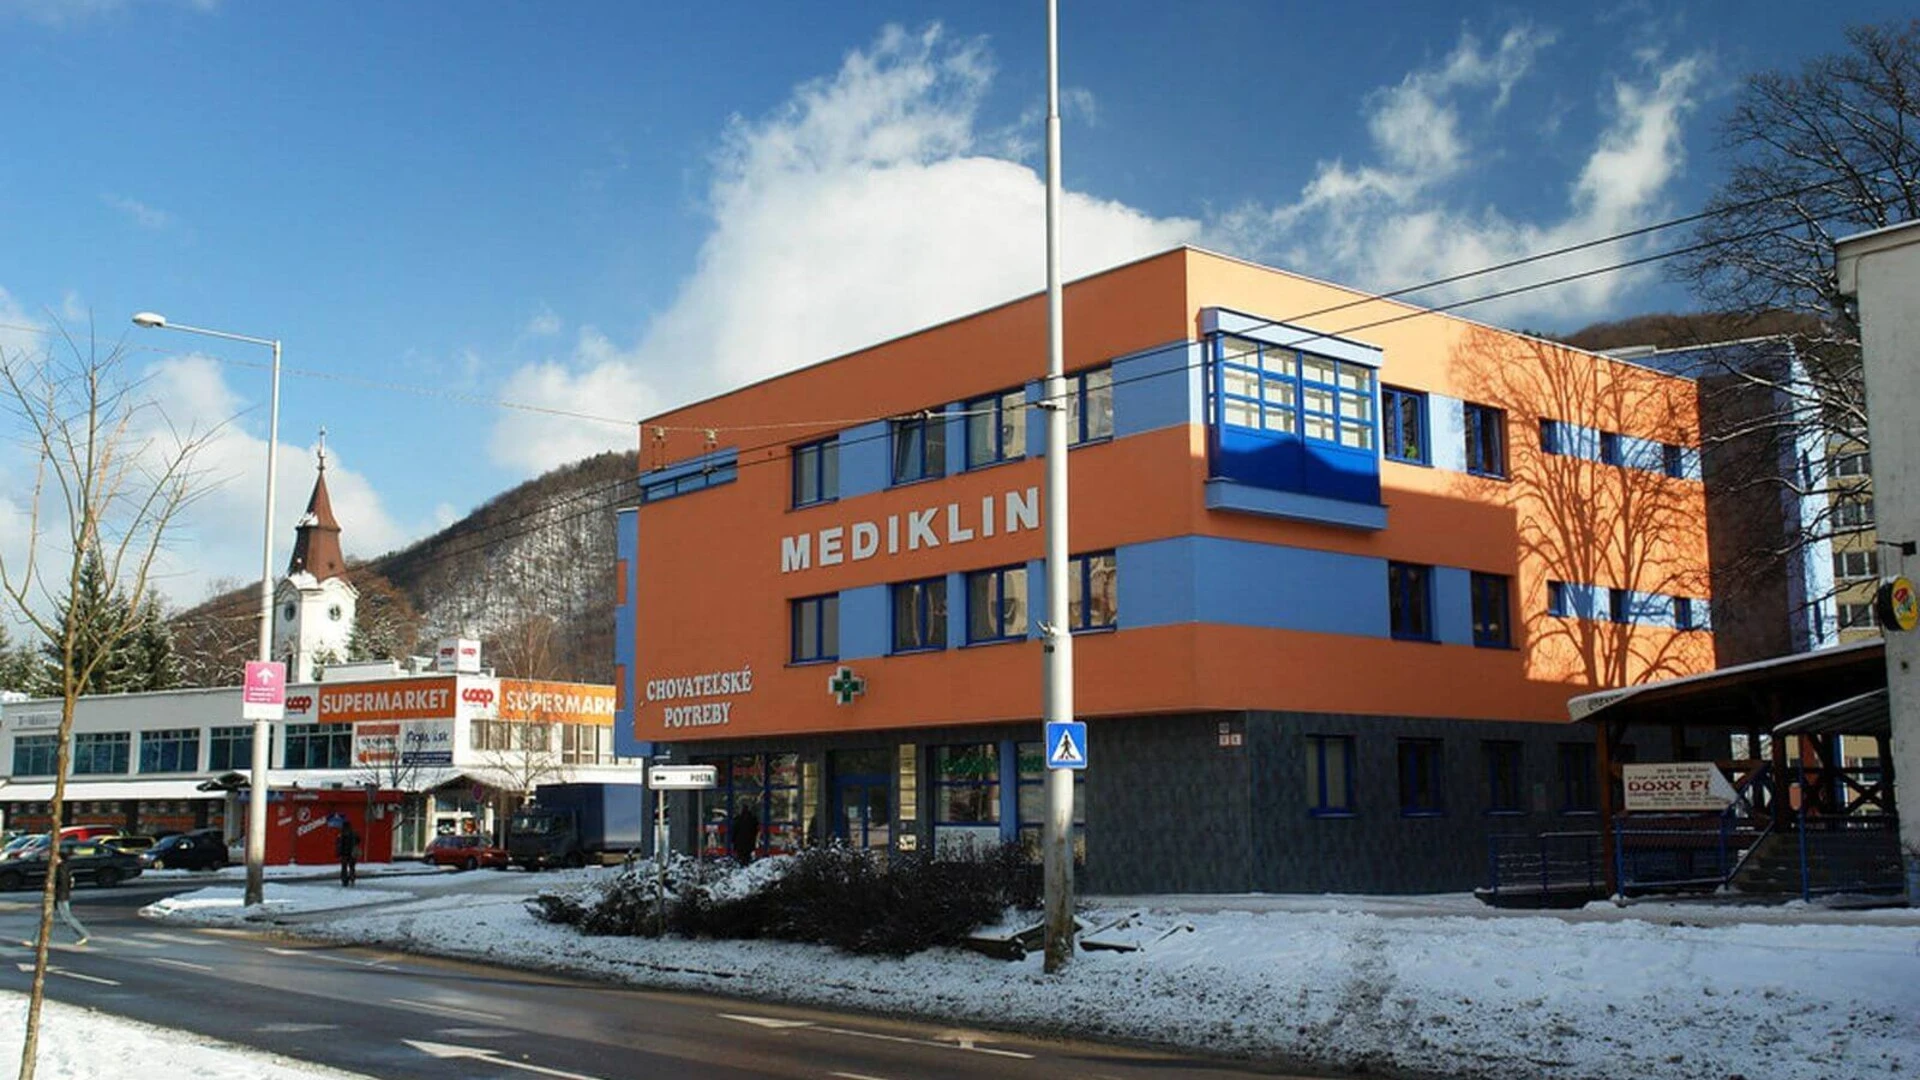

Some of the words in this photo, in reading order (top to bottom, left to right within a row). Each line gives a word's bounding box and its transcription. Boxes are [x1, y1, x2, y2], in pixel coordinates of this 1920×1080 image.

[781, 486, 1040, 573] MEDIKLIN
[321, 689, 449, 714] SUPERMARKET
[462, 687, 494, 708] coop
[664, 702, 731, 728] POTREBY
[1627, 780, 1682, 791] DOXX
